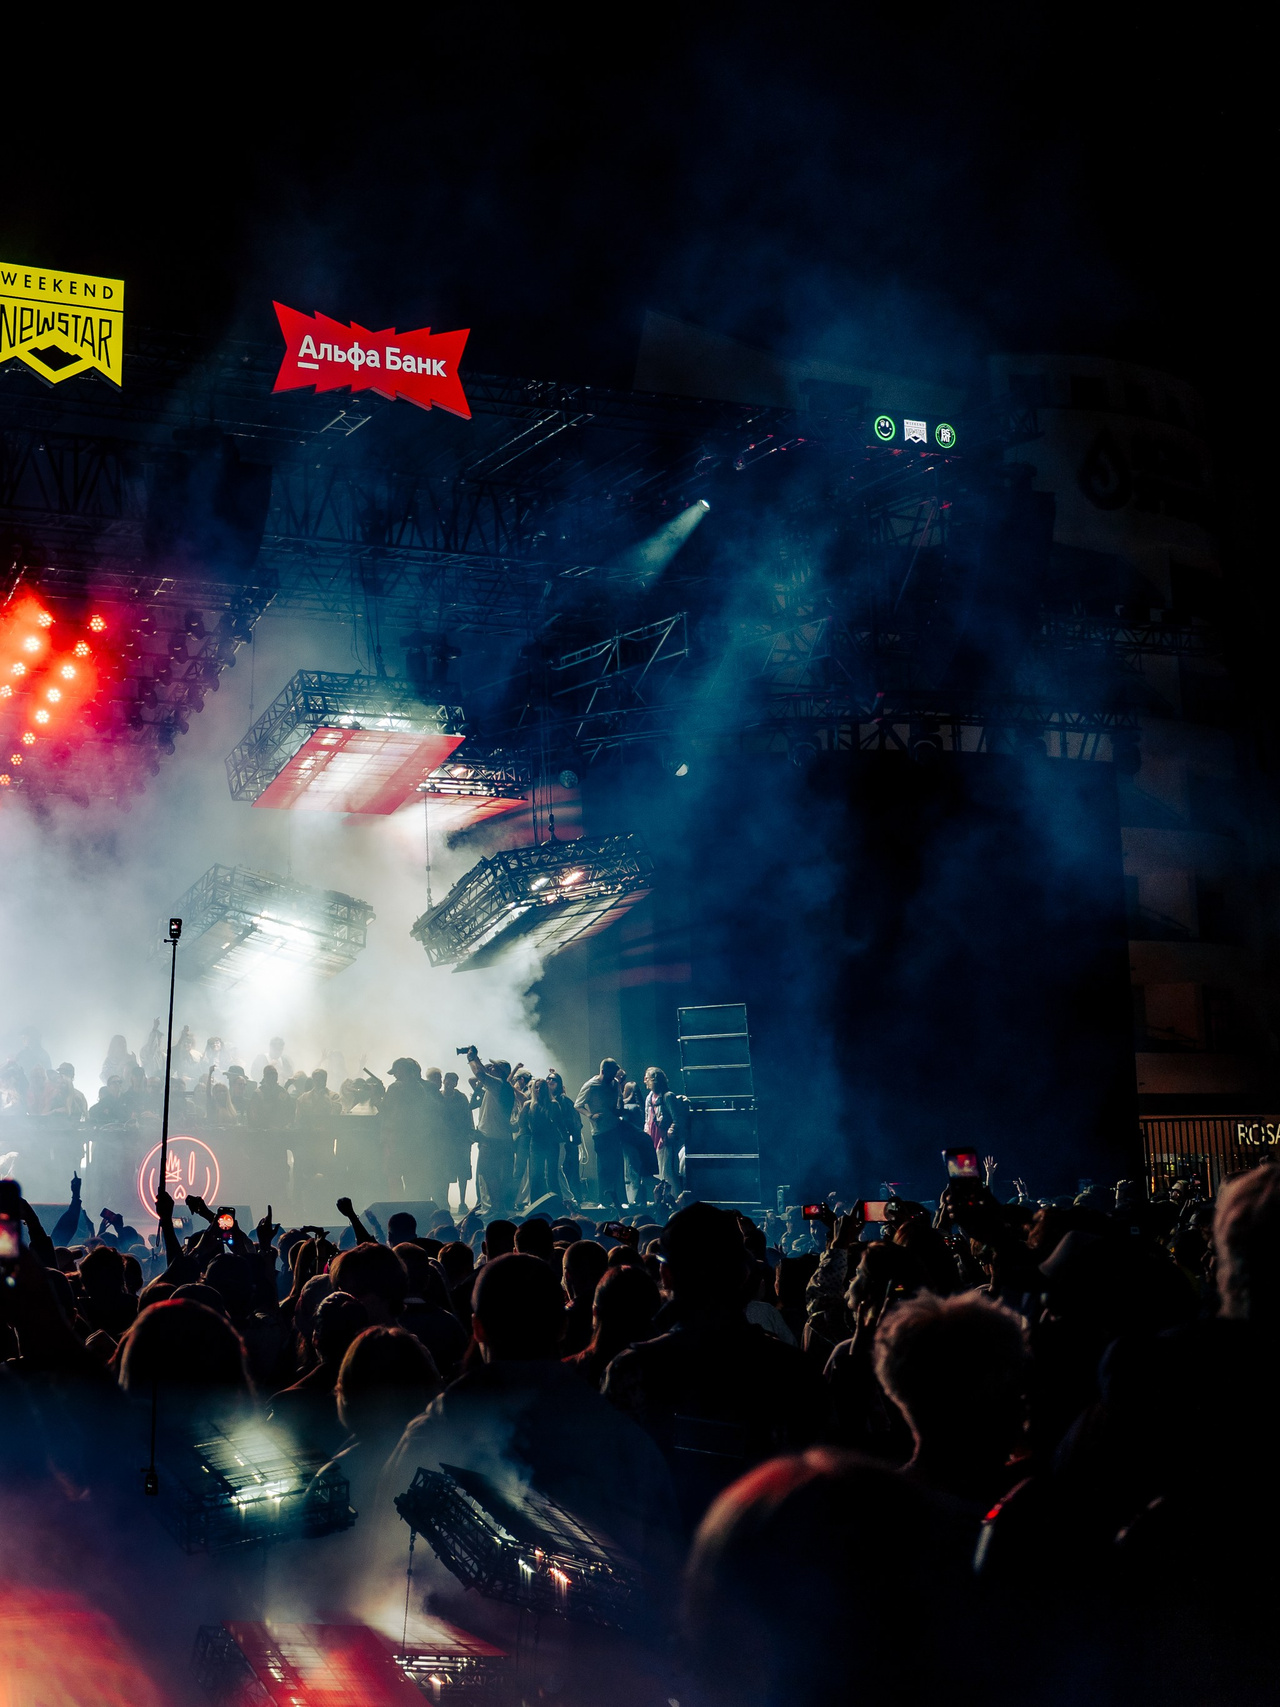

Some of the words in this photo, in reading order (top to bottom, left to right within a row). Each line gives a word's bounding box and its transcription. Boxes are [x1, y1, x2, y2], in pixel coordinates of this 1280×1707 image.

[0, 270, 114, 300] WEEKEND
[297, 334, 381, 372] Альфа
[385, 346, 448, 378] Банк
